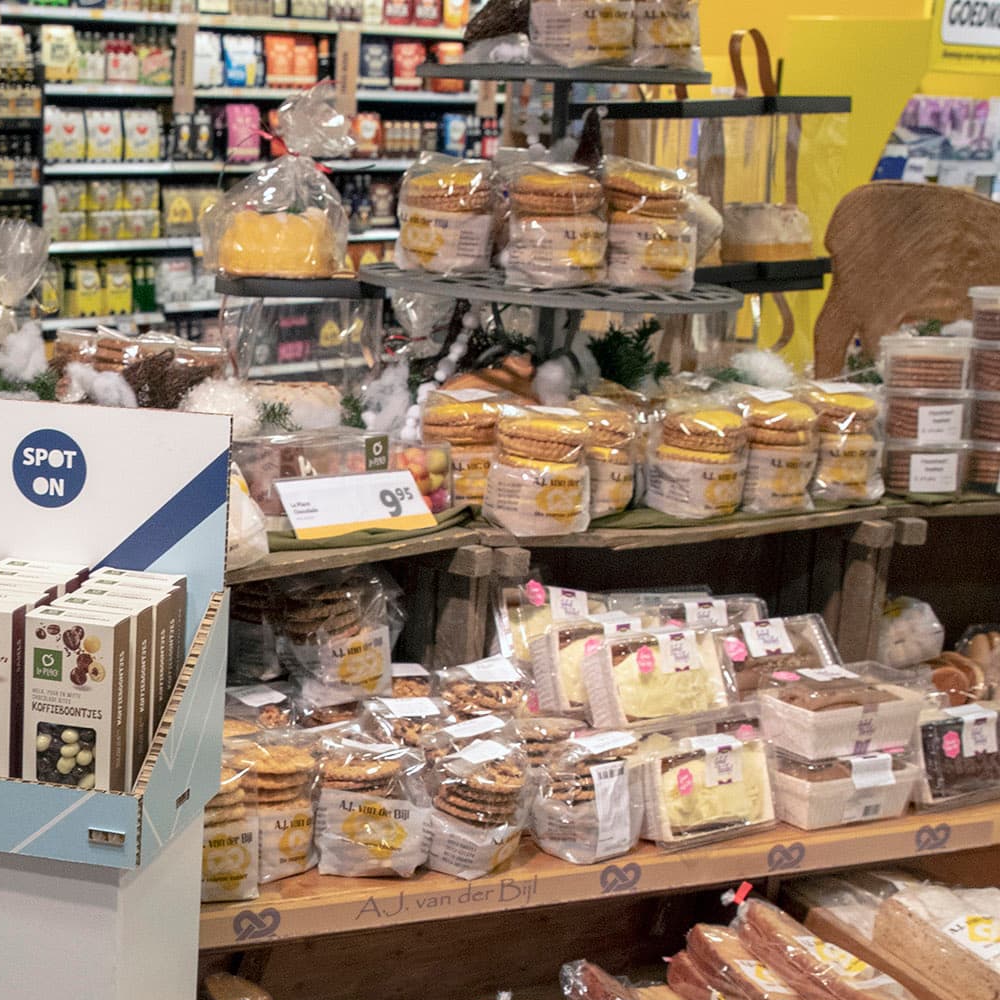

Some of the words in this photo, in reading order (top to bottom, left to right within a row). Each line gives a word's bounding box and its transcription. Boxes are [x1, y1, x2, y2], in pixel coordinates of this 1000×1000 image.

[22, 447, 77, 469] SPOT
[32, 476, 65, 497] ON
[32, 701, 103, 720] KOFFIEBOONTJES
[416, 896, 451, 910] van
[458, 883, 494, 904] der
[498, 875, 537, 905] Bijl
